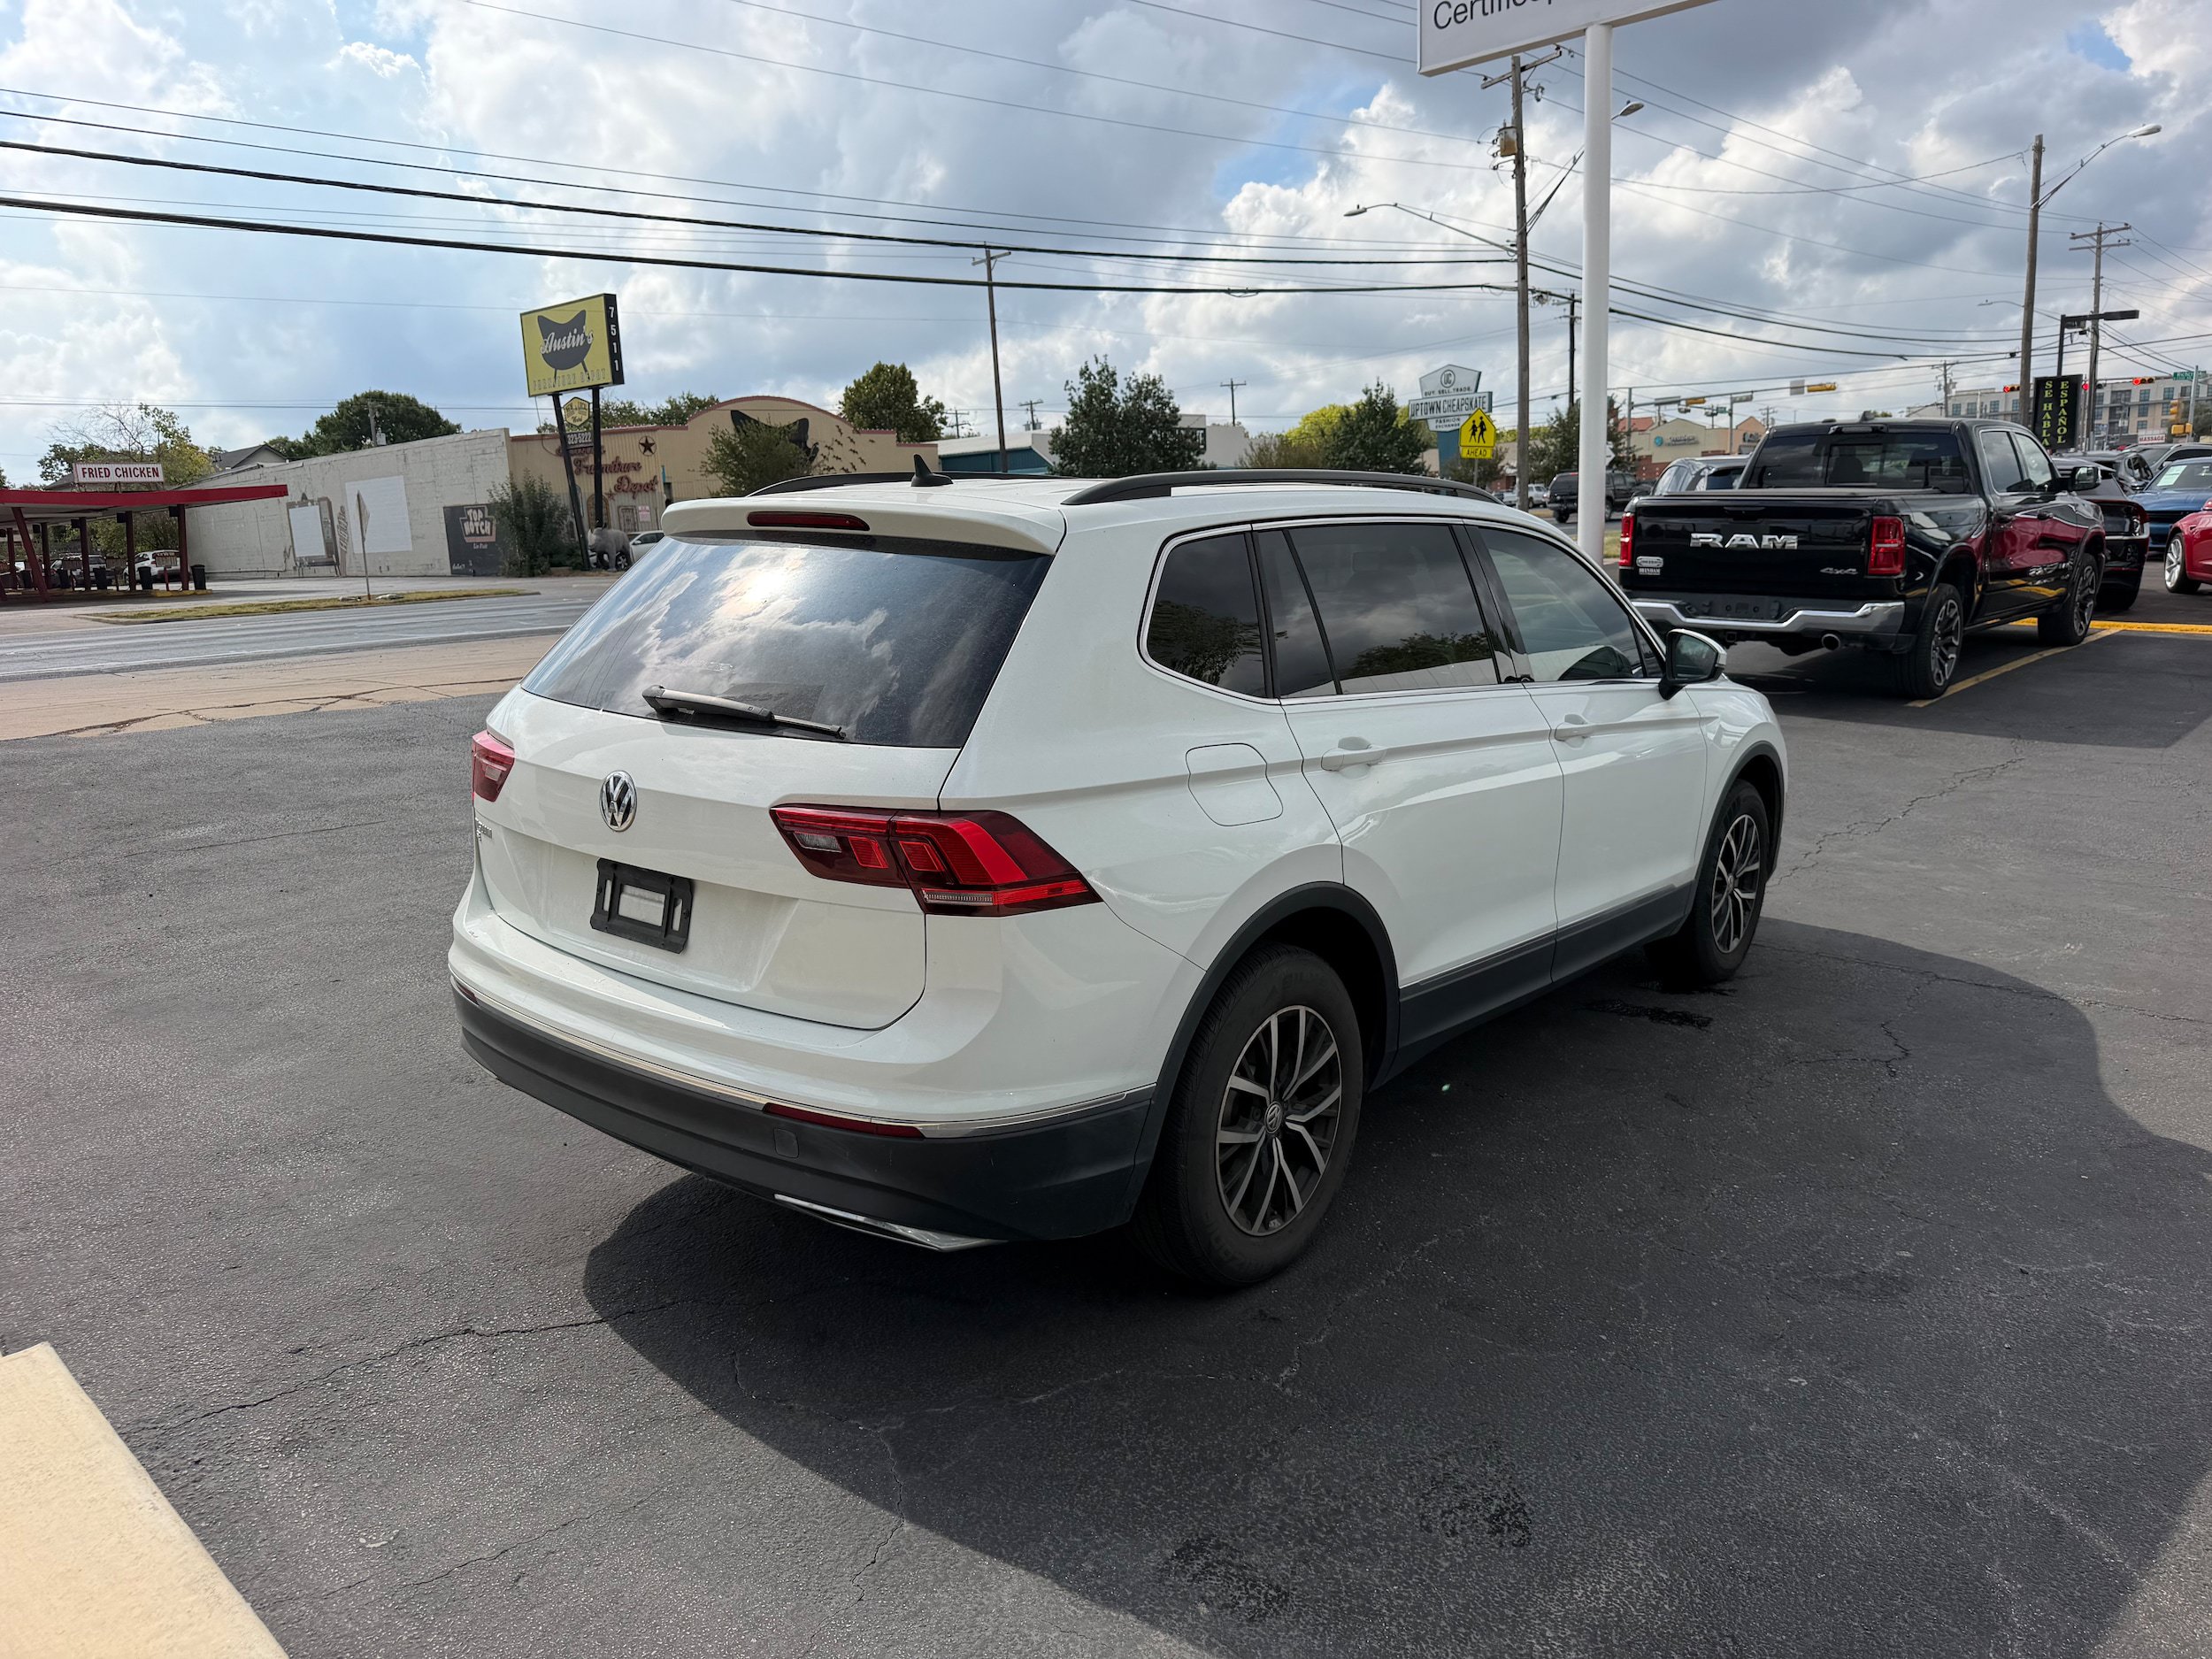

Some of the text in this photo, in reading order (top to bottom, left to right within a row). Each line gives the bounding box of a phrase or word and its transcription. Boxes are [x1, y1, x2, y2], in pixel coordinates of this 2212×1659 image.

[540, 325, 594, 354] Austin's
[608, 306, 619, 372] 7511
[1410, 396, 1486, 418] UPTOWN CHEAPSKATE
[2041, 380, 2053, 446] SE HABLA
[2056, 380, 2070, 443] ESPAÑOL
[1466, 448, 1487, 457] AHEAD
[81, 466, 160, 479] FRIED CHICKEN
[613, 474, 659, 500] Depot
[467, 508, 484, 521] TOP
[464, 519, 491, 536] NOTCH
[1689, 533, 1799, 550] RAM
